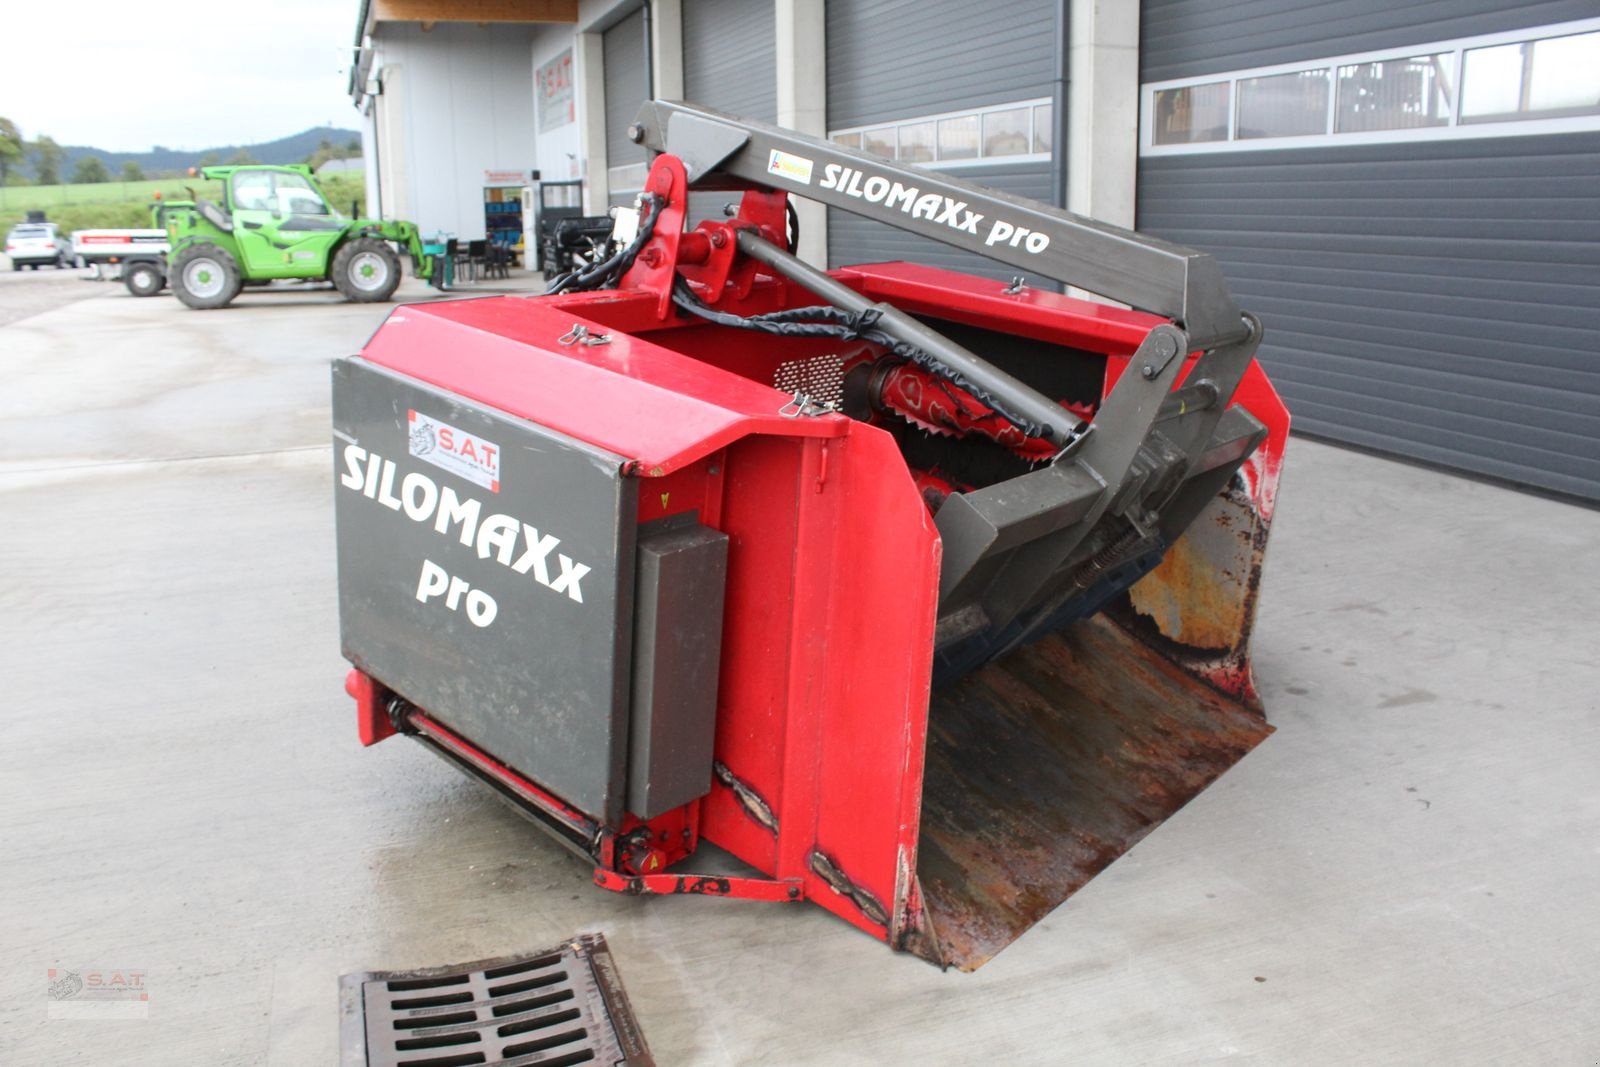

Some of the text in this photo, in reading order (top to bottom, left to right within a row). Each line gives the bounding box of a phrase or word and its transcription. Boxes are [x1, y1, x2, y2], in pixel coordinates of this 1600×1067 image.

[984, 219, 1051, 254] pro
[438, 427, 497, 470] S.A.T.
[415, 559, 498, 628] pro
